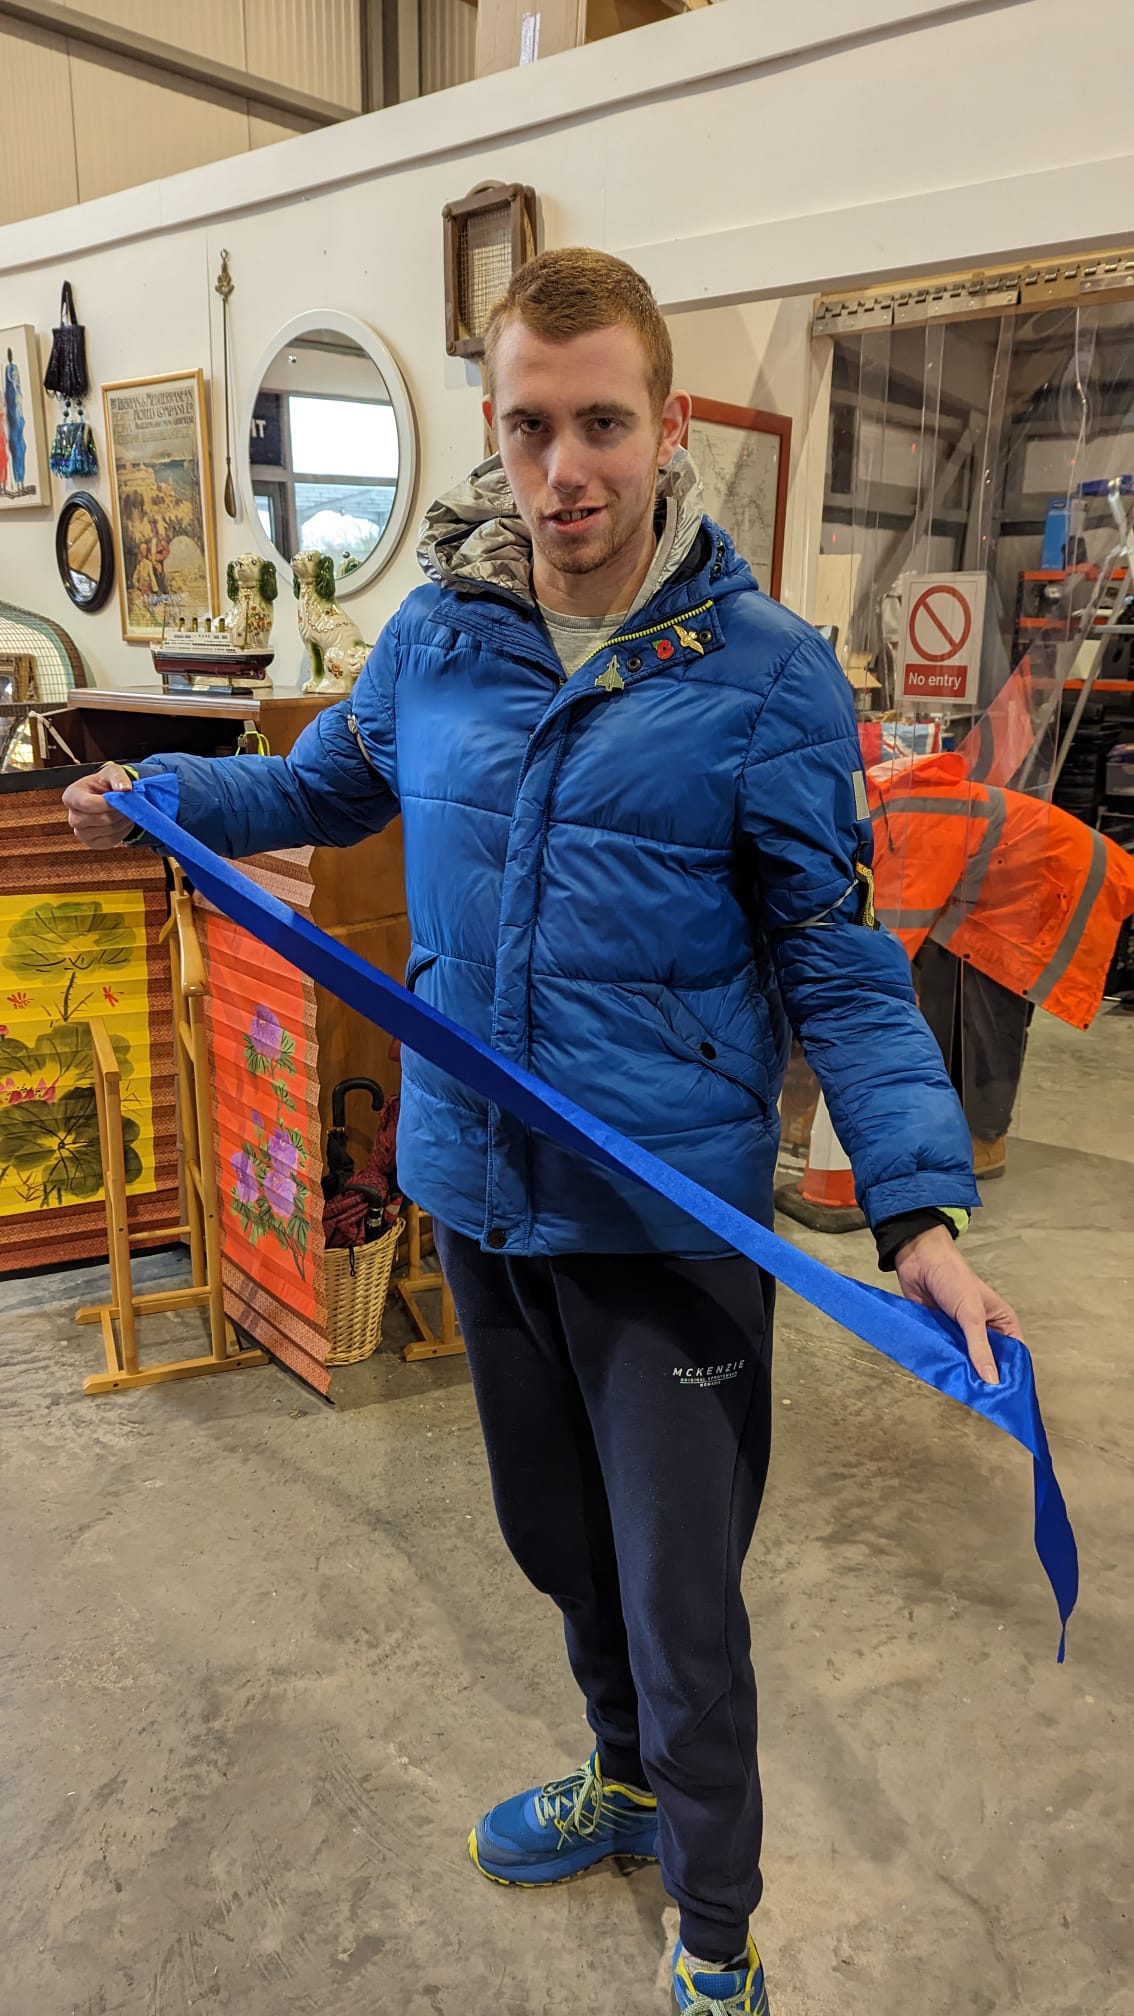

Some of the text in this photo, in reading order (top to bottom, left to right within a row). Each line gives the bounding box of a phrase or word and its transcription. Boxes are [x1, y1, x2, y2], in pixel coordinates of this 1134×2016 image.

[908, 672, 962, 690] No entry
[672, 1359, 745, 1377] MCKENZIE
